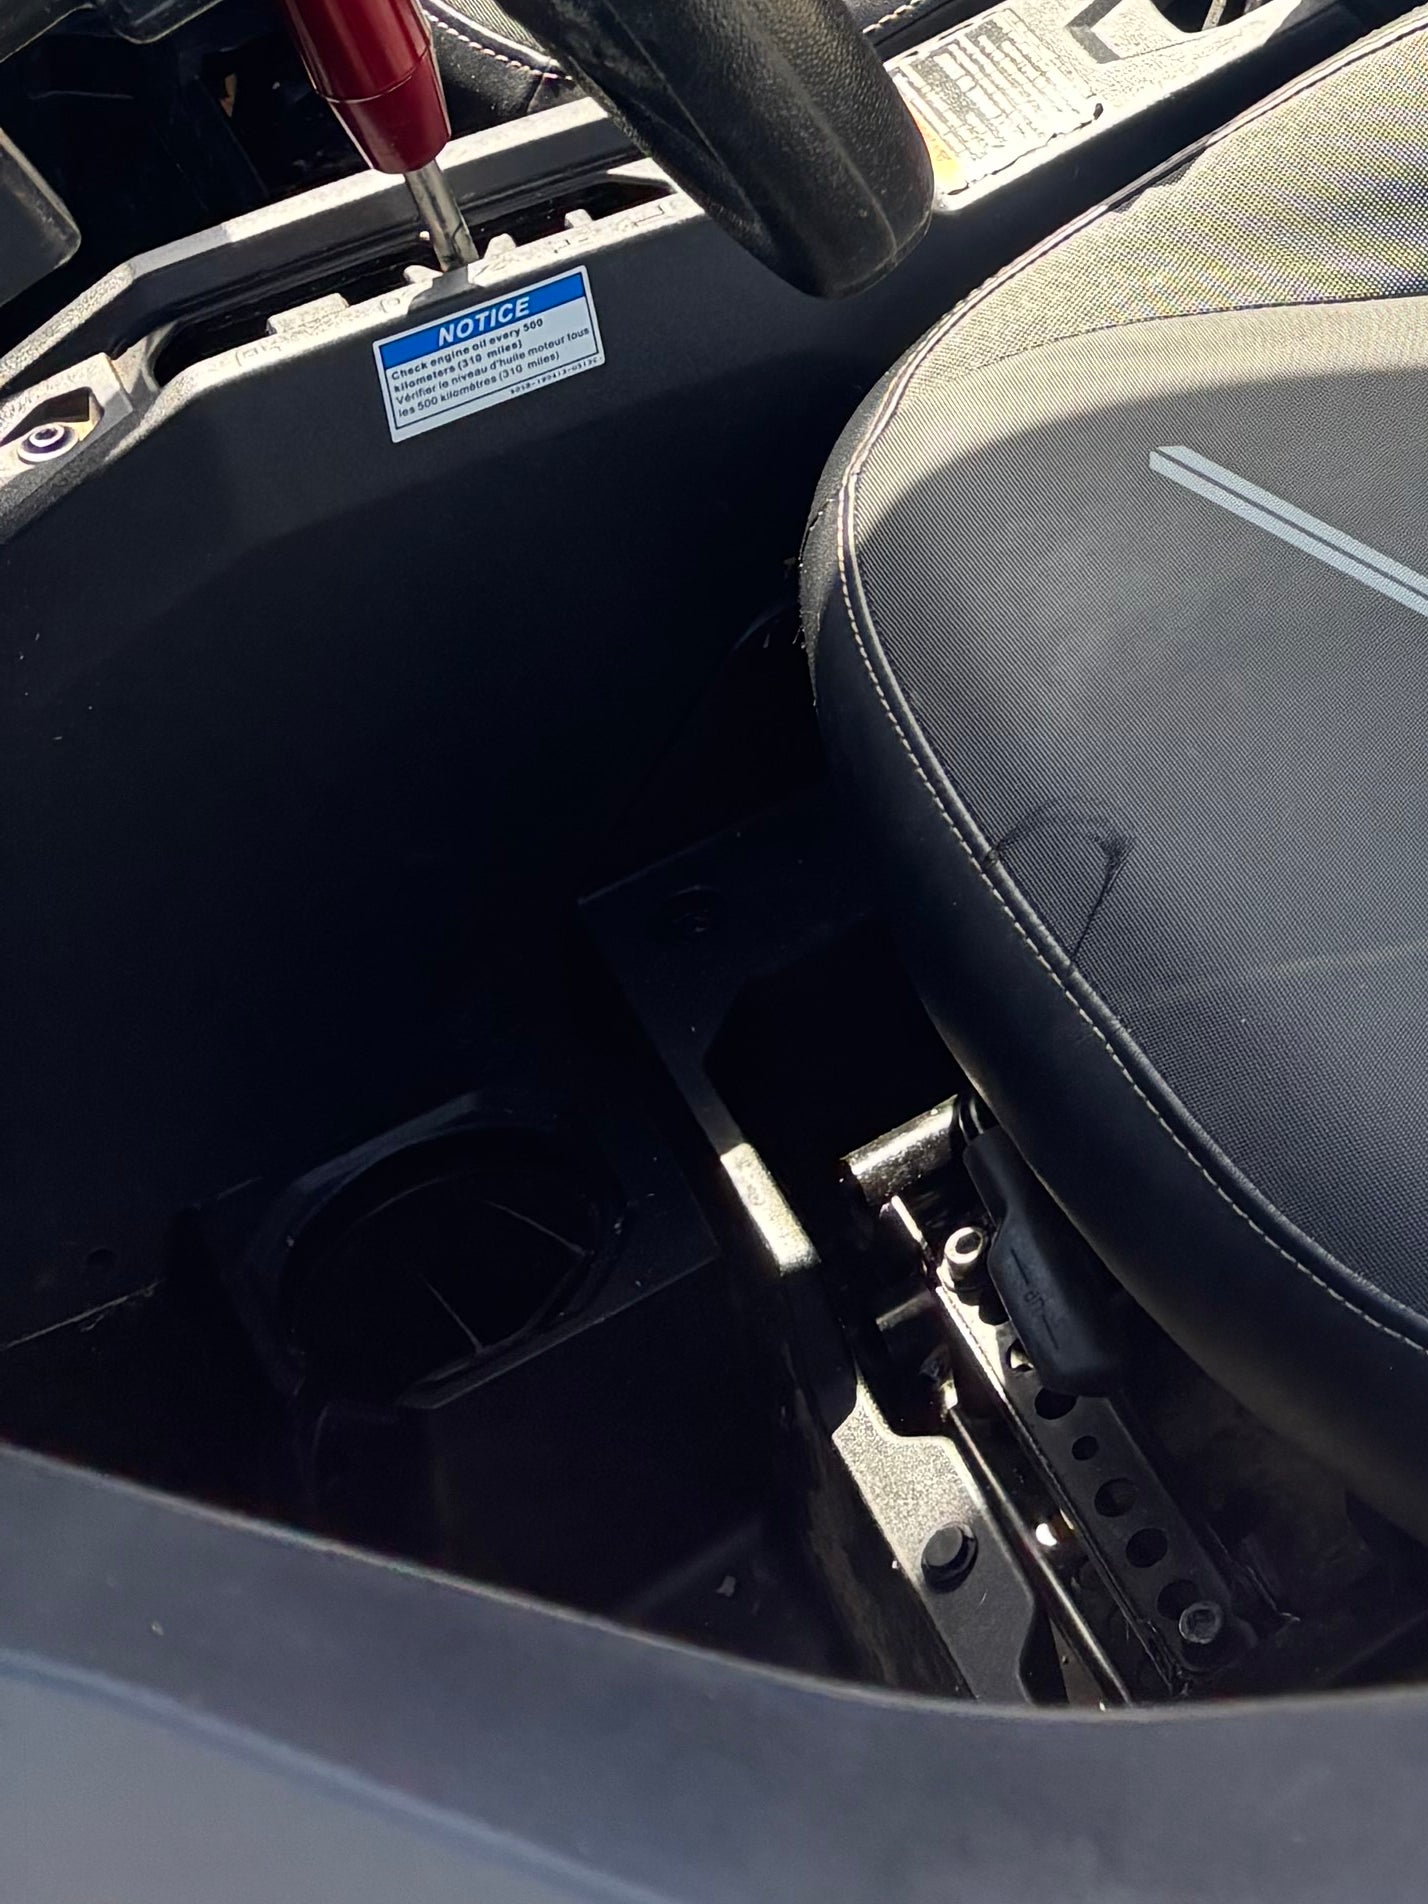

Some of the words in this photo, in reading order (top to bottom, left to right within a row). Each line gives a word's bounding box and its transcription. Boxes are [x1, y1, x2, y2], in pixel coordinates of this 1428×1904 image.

[391, 360, 428, 381] Check
[430, 346, 470, 368] engine
[472, 338, 487, 351] oil
[489, 327, 521, 346] every
[523, 317, 543, 333] 500
[438, 296, 530, 346] NOTICE
[394, 365, 456, 393] kilometers
[457, 354, 482, 373] (310
[487, 338, 523, 362] miles)
[396, 385, 437, 406] Vérifier
[438, 378, 450, 390] le
[451, 366, 488, 387] niveau
[528, 336, 565, 357] moteur
[568, 327, 590, 343] tous
[398, 403, 415, 418] les
[417, 396, 438, 411] 500
[440, 375, 497, 402] kilomètres
[498, 365, 523, 384] (310
[527, 351, 560, 374] miles)
